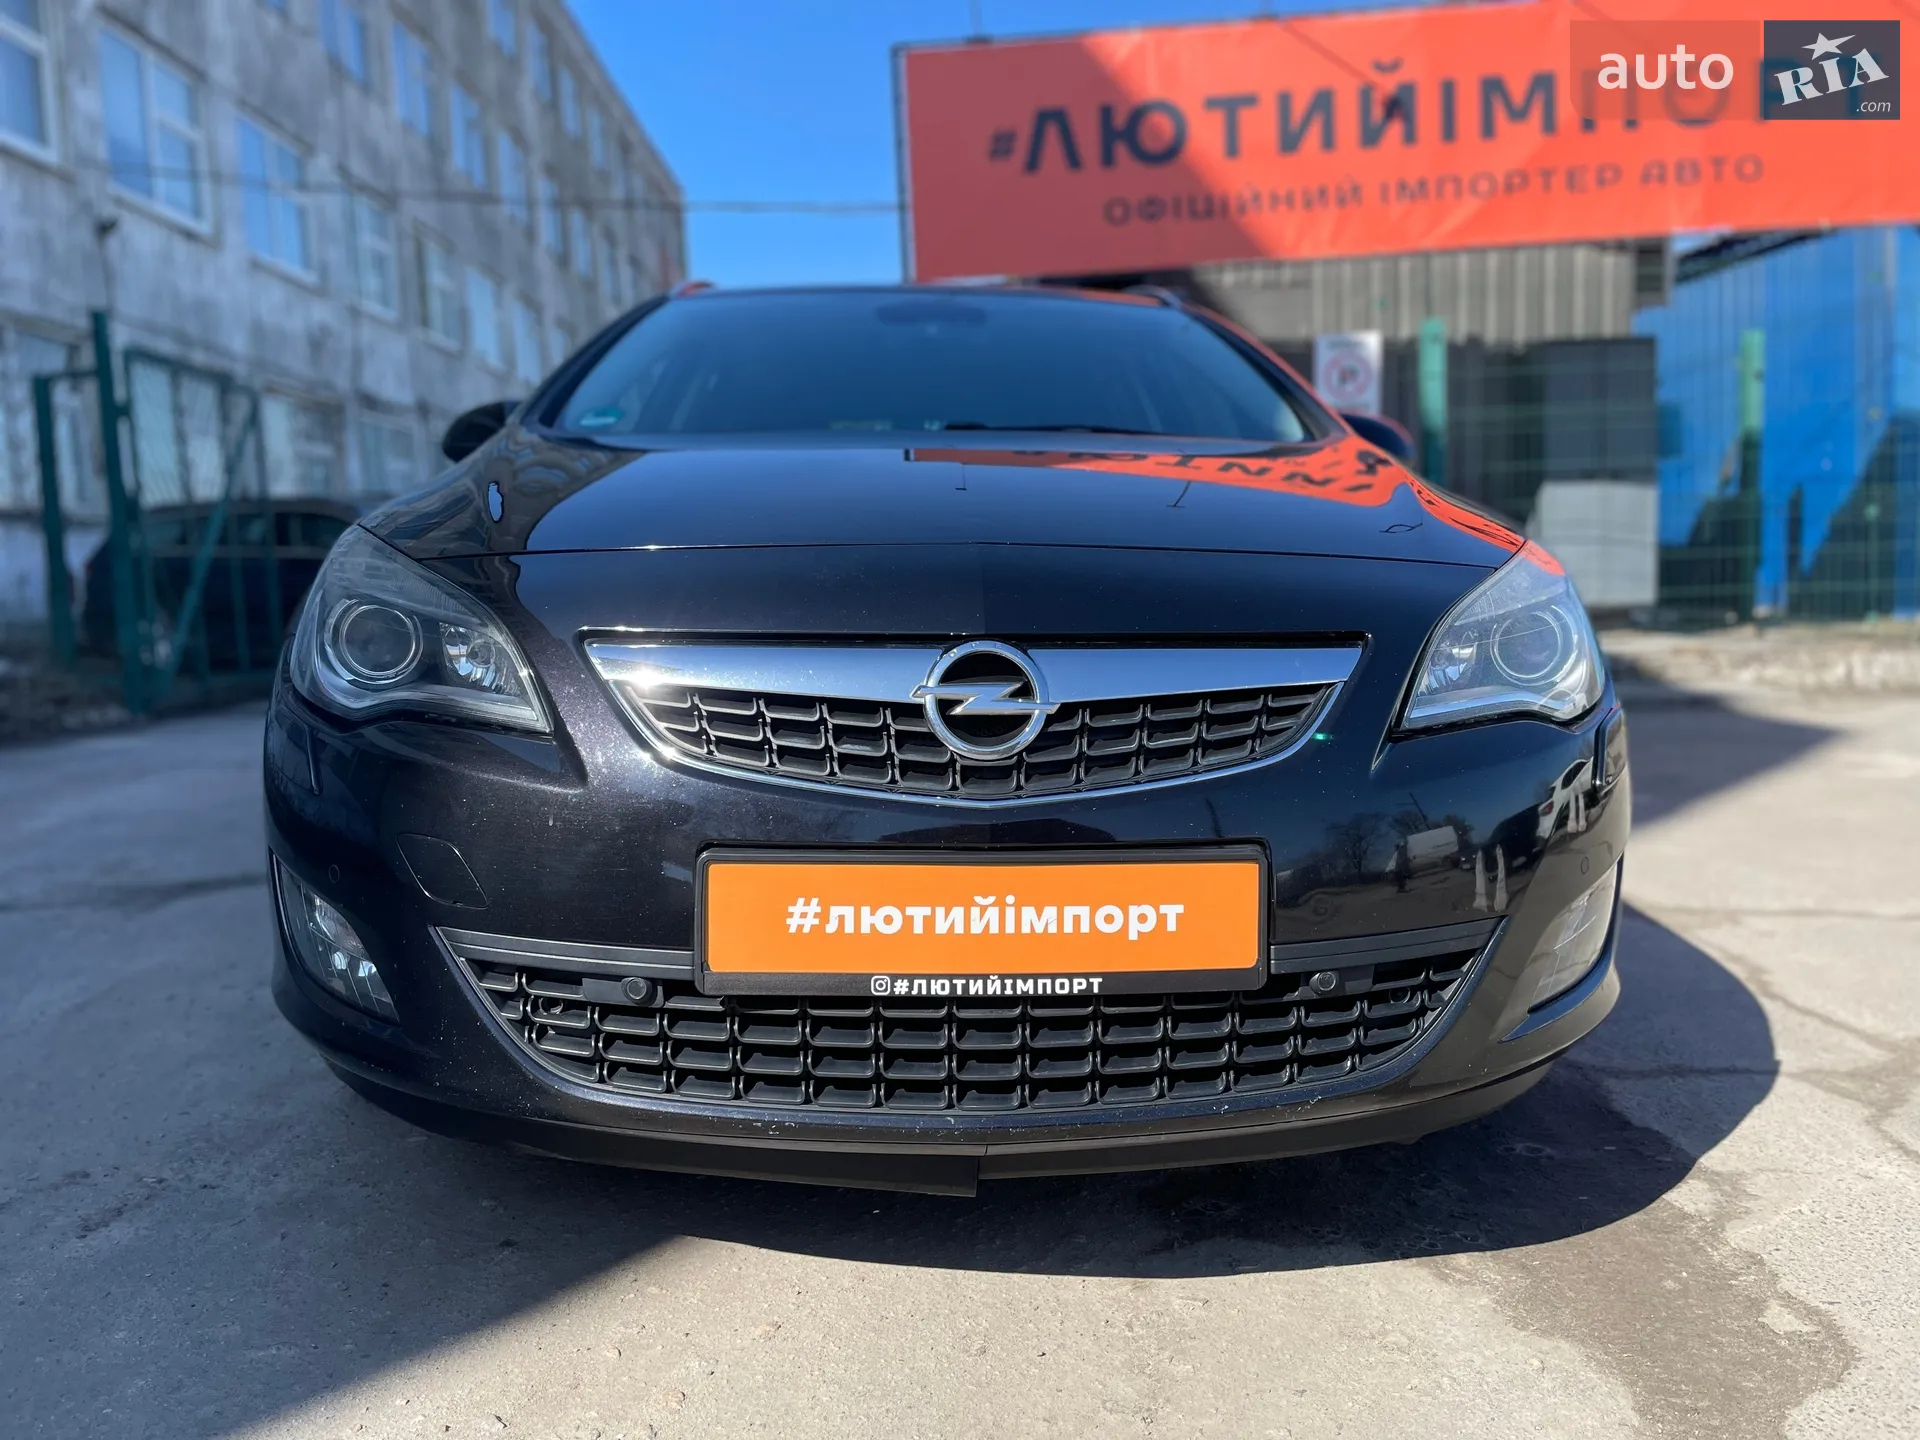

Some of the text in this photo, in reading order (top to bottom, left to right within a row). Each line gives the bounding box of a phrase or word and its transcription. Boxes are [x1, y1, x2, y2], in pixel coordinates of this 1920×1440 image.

[1103, 153, 1765, 227] ОФІЦІЙНИЙ ІМПОРТЕР АВТО
[786, 894, 1185, 941] #лютийімпорт
[893, 975, 1103, 995] #ЛЮТИЙІМПОРТ
